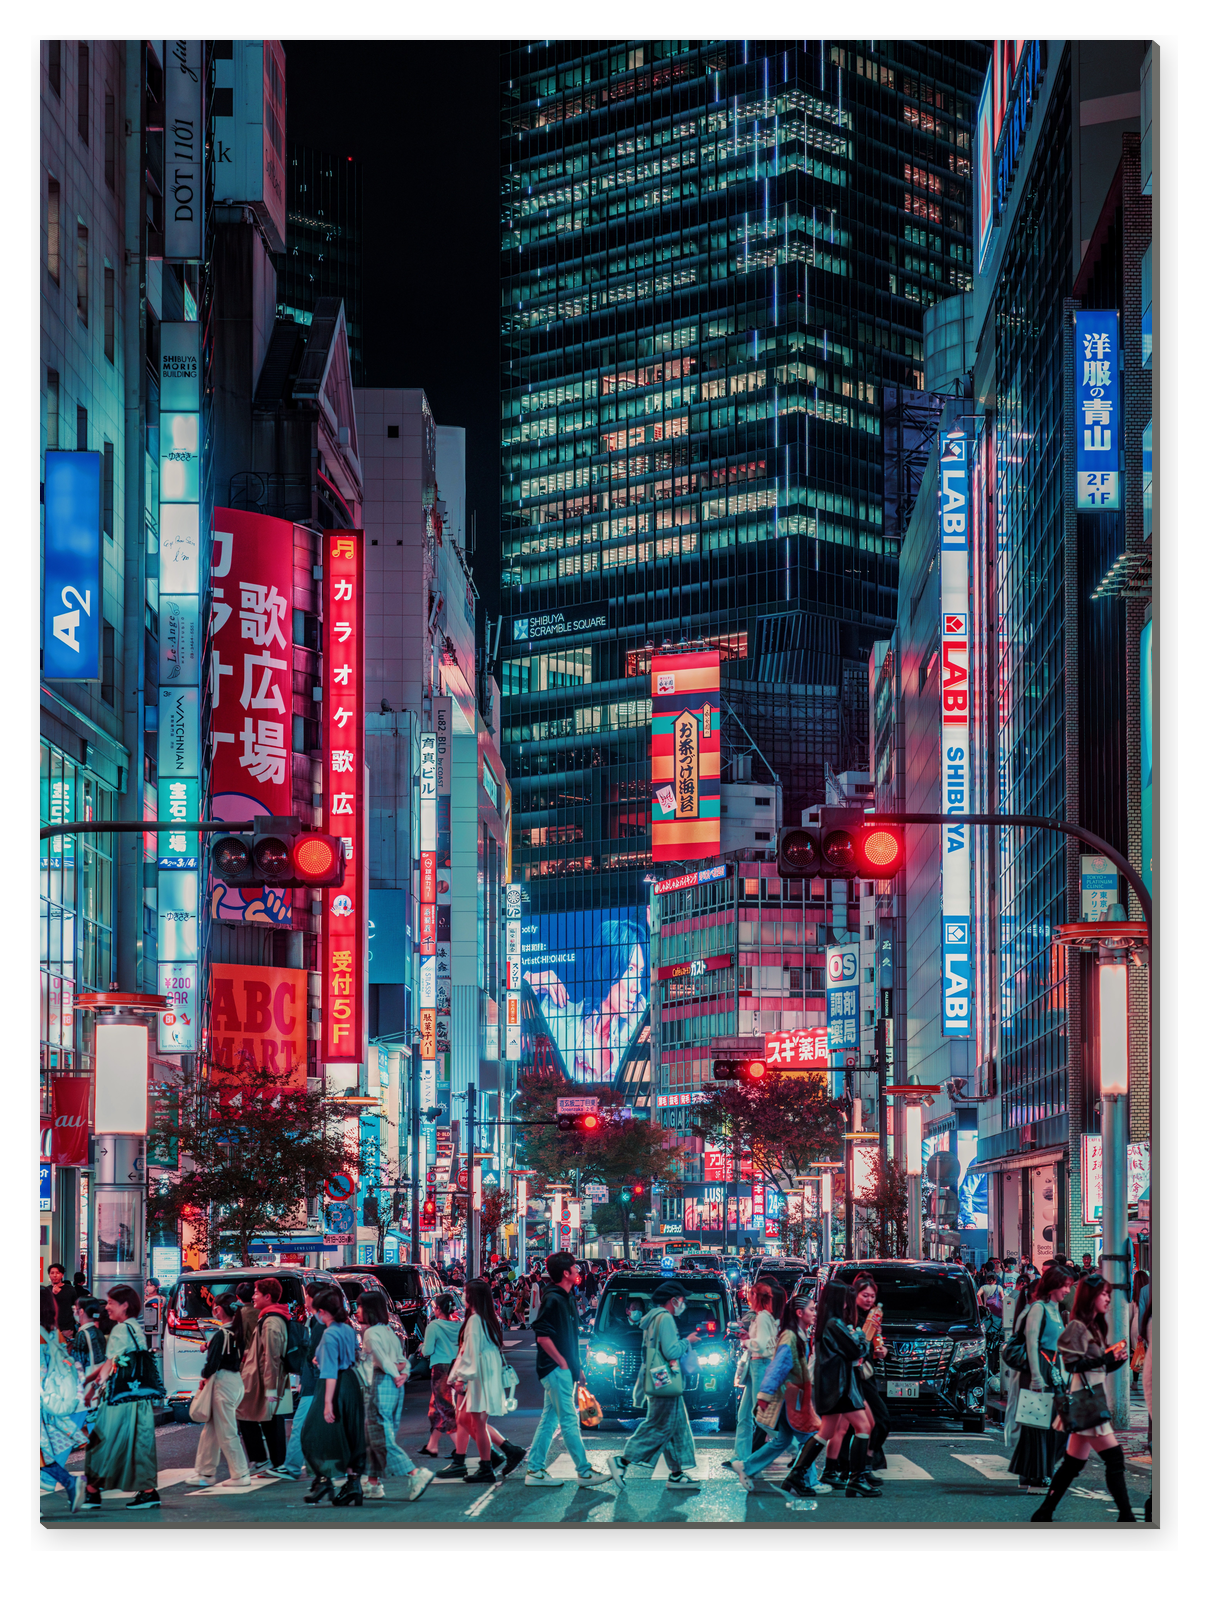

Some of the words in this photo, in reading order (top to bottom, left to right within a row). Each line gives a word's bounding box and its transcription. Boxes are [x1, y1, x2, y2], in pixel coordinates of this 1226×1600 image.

[172, 118, 193, 161] 1101
[172, 168, 193, 222] DOT
[1081, 332, 1113, 451] 洋服の青山
[1086, 473, 1111, 486] 2F
[943, 470, 965, 544] LABI
[1087, 492, 1111, 505] 1F
[53, 585, 91, 653] A2
[529, 613, 564, 627] SHIBUYA
[529, 623, 573, 638] SCRAMBLE
[573, 616, 606, 631] SQUARE
[238, 581, 288, 785] 歌広場
[943, 641, 967, 726] LABI
[678, 722, 696, 813] お茶づけ海苔
[421, 935, 435, 951] 千
[690, 959, 707, 976] ガスト
[830, 954, 856, 979] OS
[164, 977, 191, 989] ¥200
[332, 950, 353, 1044] 受付5F
[945, 953, 968, 1028] LABI
[166, 991, 189, 1004] BAR
[212, 978, 297, 1036] ABC
[830, 990, 856, 1018] 調剤
[165, 1015, 174, 1024] B1
[830, 1018, 856, 1045] 薬局
[423, 1013, 432, 1055] 駄菓子バー
[212, 1037, 297, 1074] MART
[767, 1035, 828, 1064] スギ薬局
[55, 1114, 86, 1127] au
[768, 1194, 778, 1214] 24
